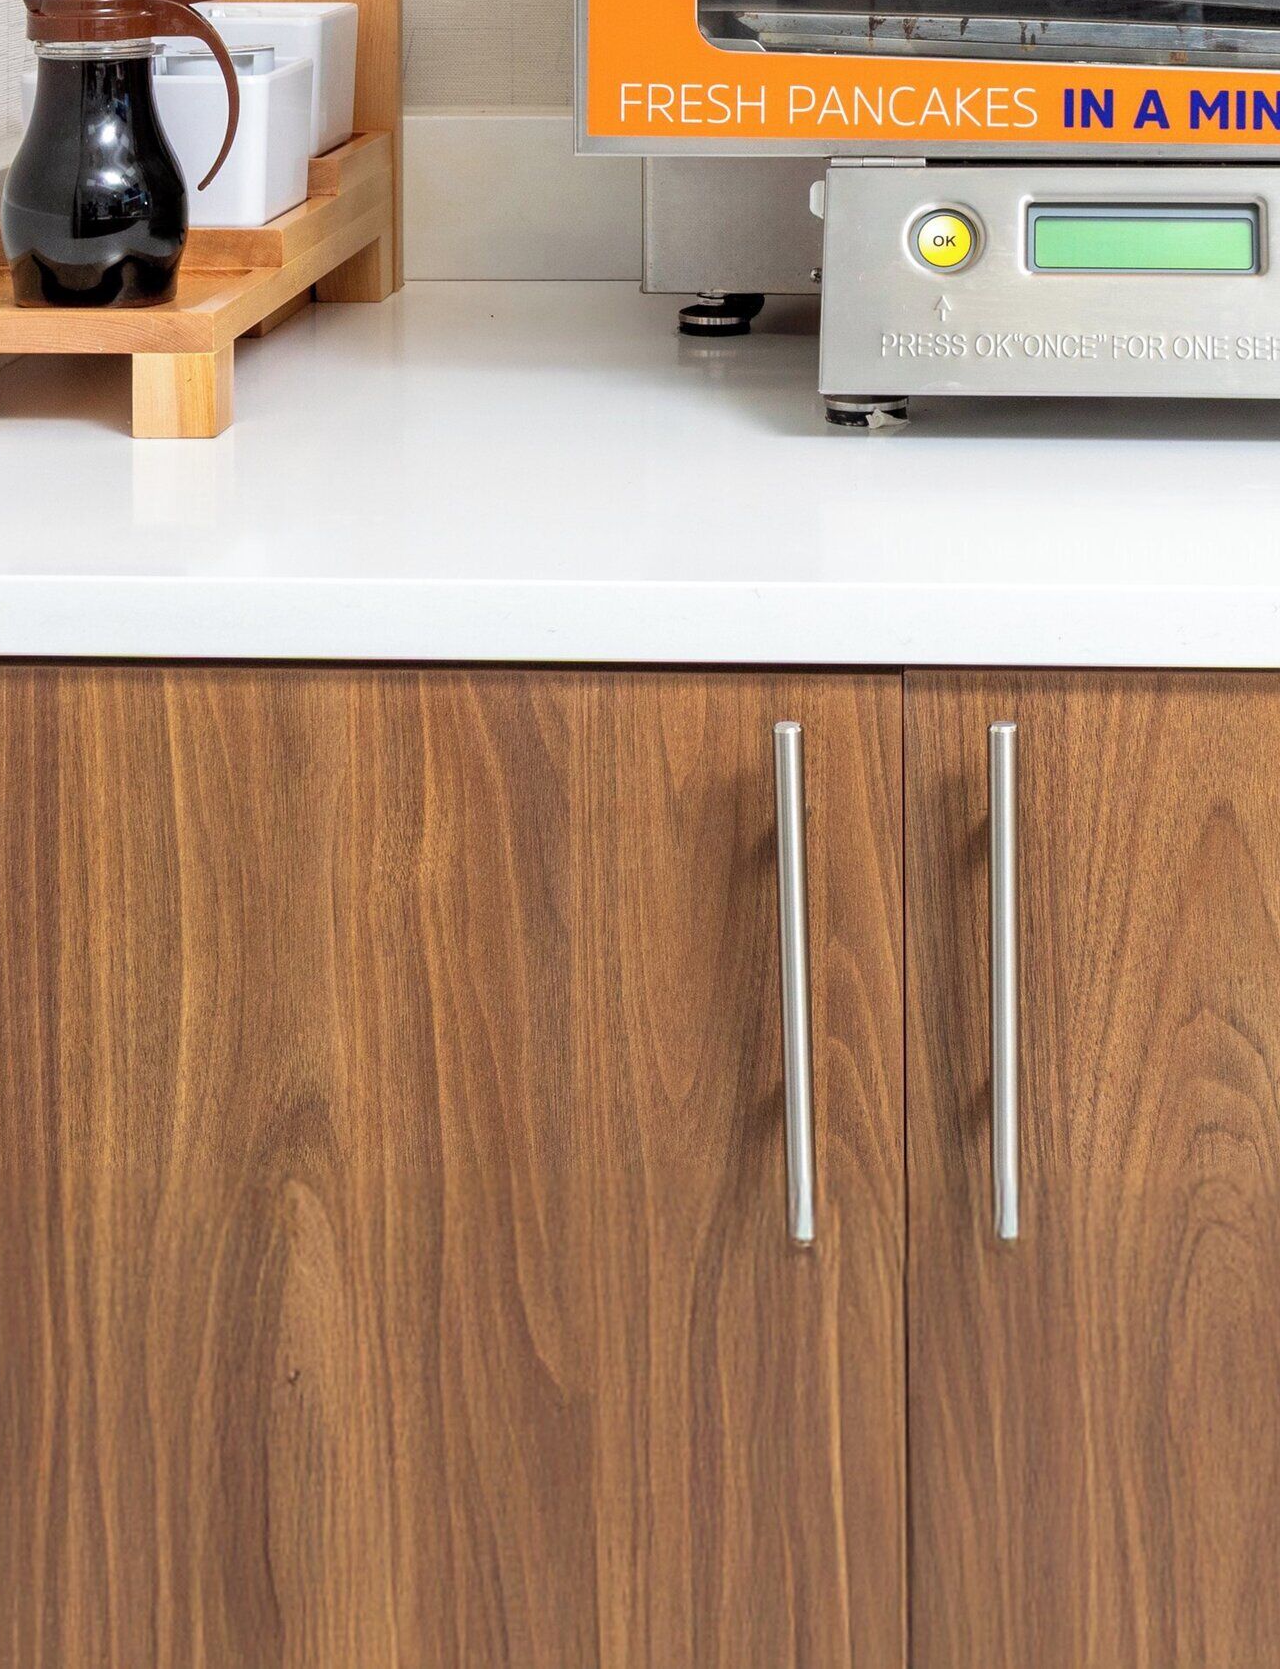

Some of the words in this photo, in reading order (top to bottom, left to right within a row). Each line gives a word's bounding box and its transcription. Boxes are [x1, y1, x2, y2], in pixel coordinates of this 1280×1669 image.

[620, 82, 766, 124] FRESH
[789, 84, 1039, 128] PANCAKES
[1063, 88, 1114, 129] IN
[1133, 89, 1170, 129] A
[932, 235, 957, 247] OK
[880, 332, 968, 358] PRESS
[1111, 334, 1167, 360] FOR
[1172, 335, 1229, 361] ONE
